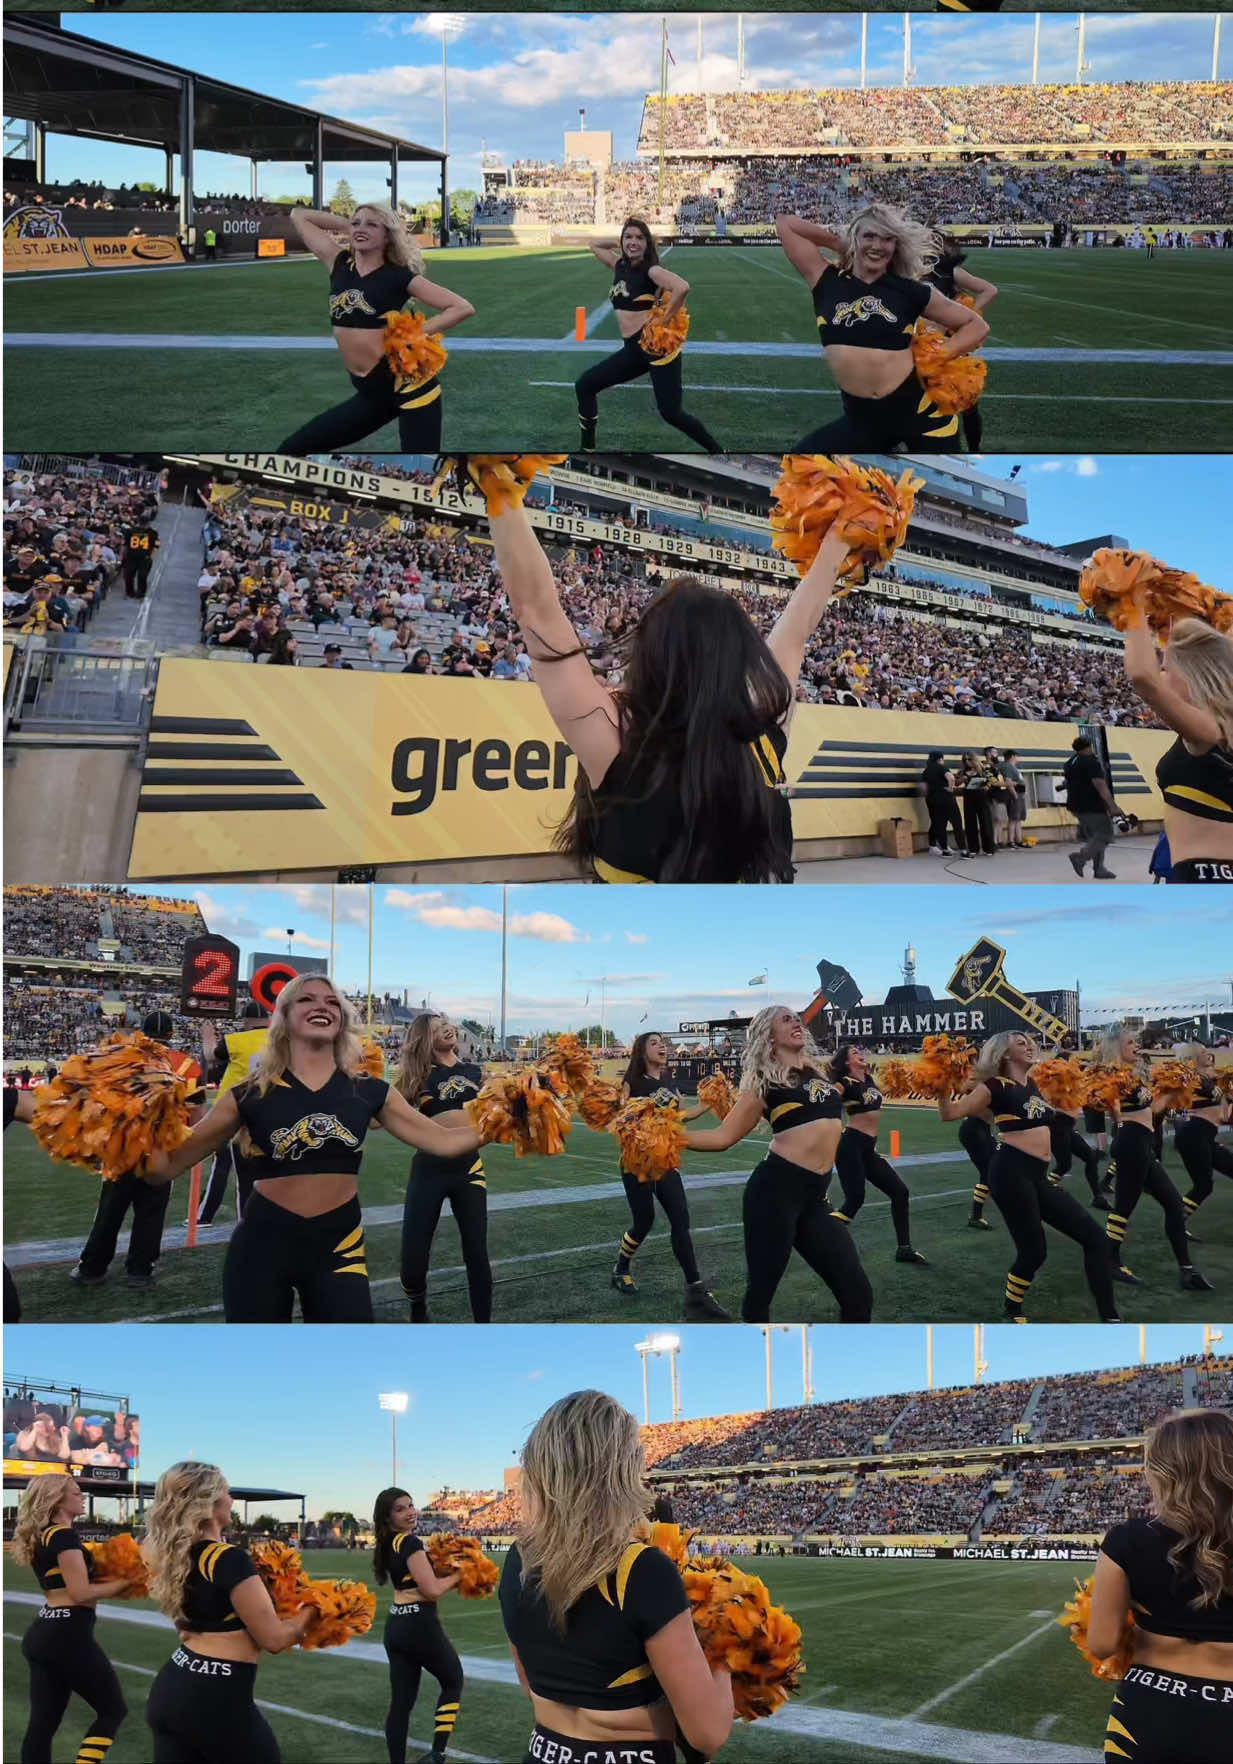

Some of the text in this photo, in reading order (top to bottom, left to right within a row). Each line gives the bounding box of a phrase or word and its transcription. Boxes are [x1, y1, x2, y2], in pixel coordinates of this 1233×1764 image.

[23, 243, 78, 255] ST.JEAN
[93, 244, 127, 255] HDAP
[290, 500, 349, 524] BOX J
[225, 454, 380, 492] CHAMPIONS
[547, 515, 585, 533] 1915
[604, 527, 641, 545] 1928
[659, 538, 693, 555] 1929
[709, 549, 741, 564] 1932
[756, 557, 785, 573] 1943
[876, 582, 900, 595] 1963
[130, 535, 149, 550] 84
[192, 950, 232, 995] 2
[834, 1010, 986, 1036] THE HAMMER
[818, 1547, 912, 1558] MICHAEL ST.JEAN
[953, 1548, 1069, 1560] MICHAEL ST.JEAN
